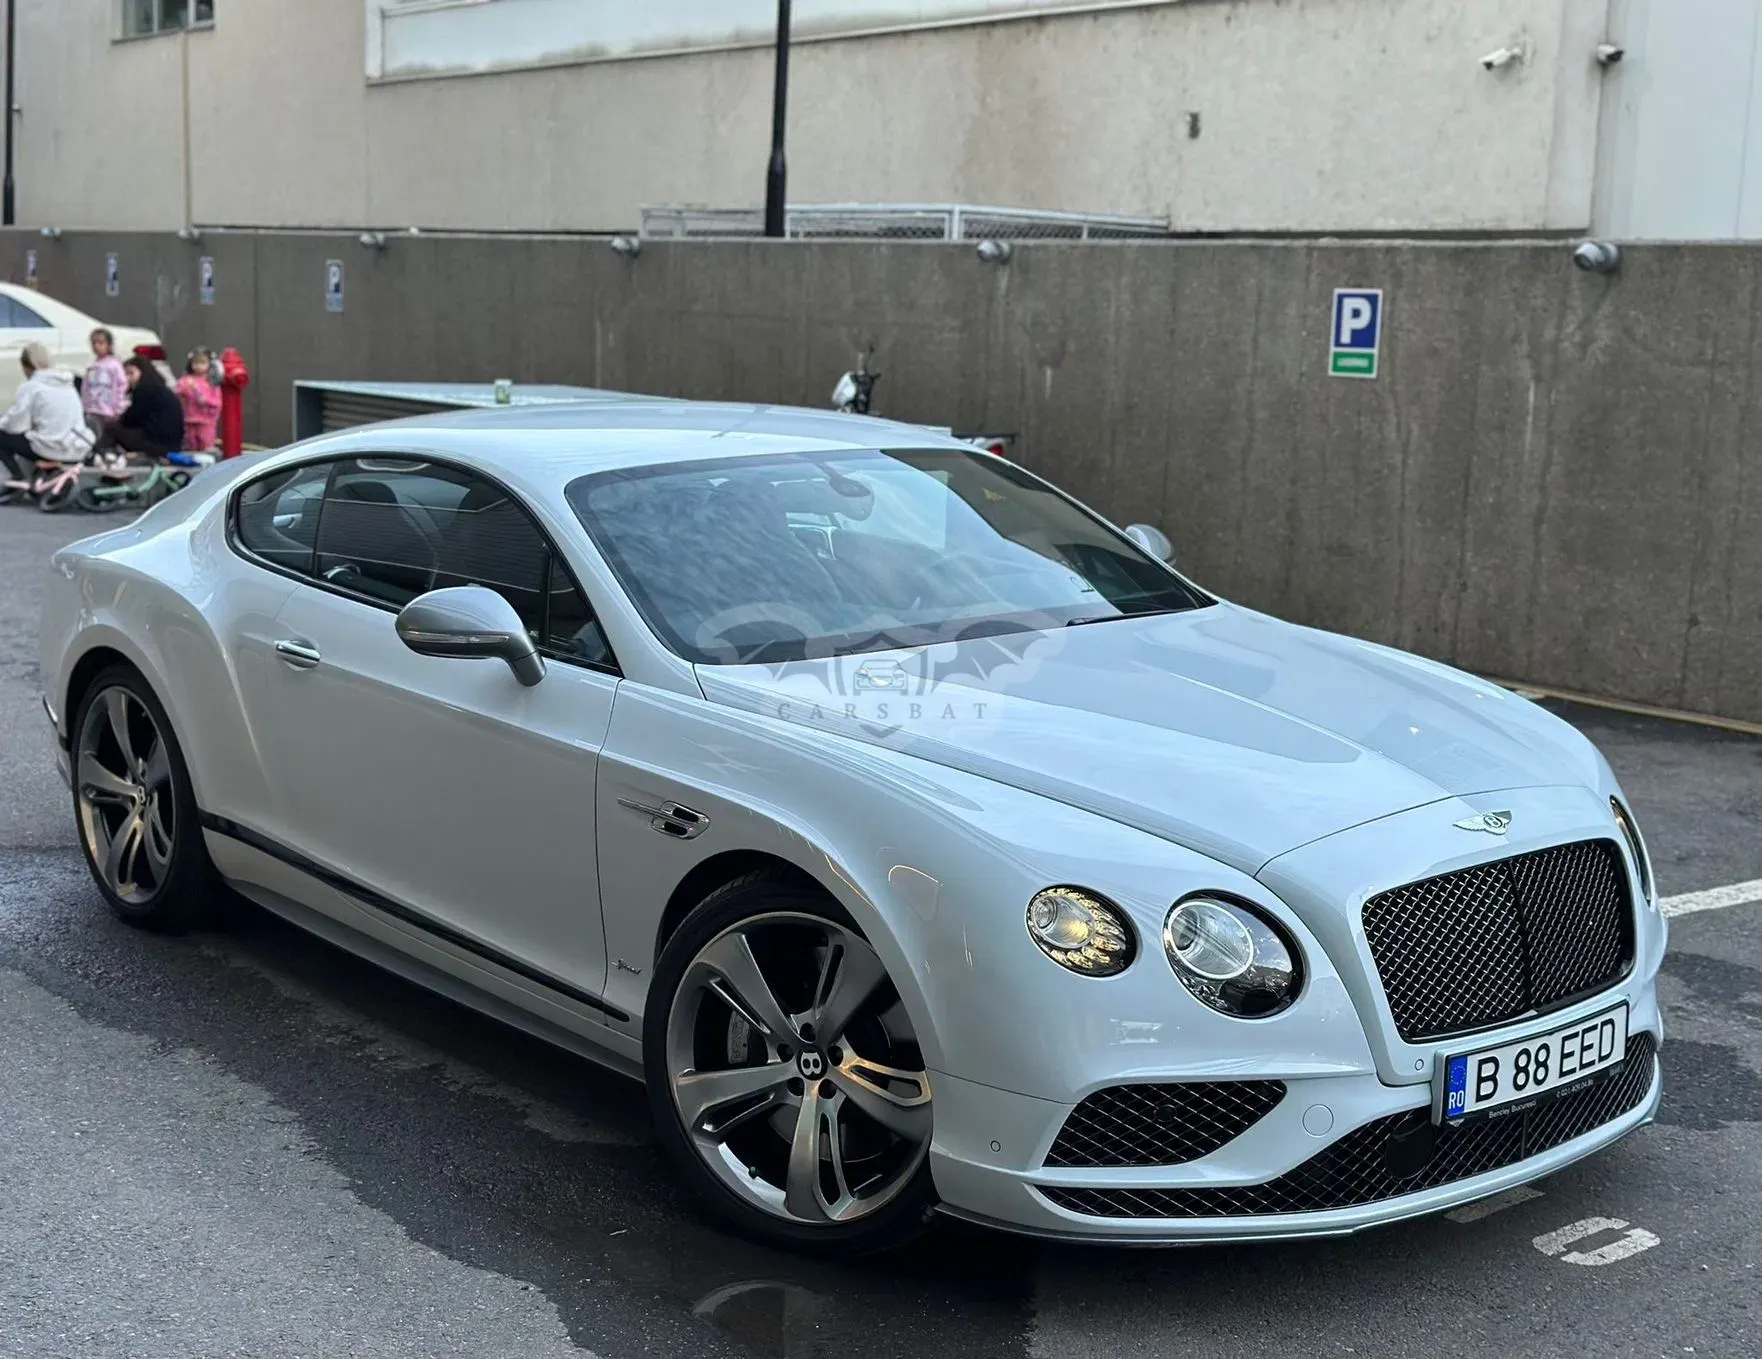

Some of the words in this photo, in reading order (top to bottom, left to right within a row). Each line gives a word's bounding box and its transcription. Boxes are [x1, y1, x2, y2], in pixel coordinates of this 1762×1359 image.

[329, 266, 340, 291] P
[1340, 297, 1372, 344] P
[1476, 1056, 1500, 1103] B
[1513, 1043, 1550, 1091] 88
[1559, 1018, 1615, 1078] EED
[1449, 1090, 1464, 1110] RO
